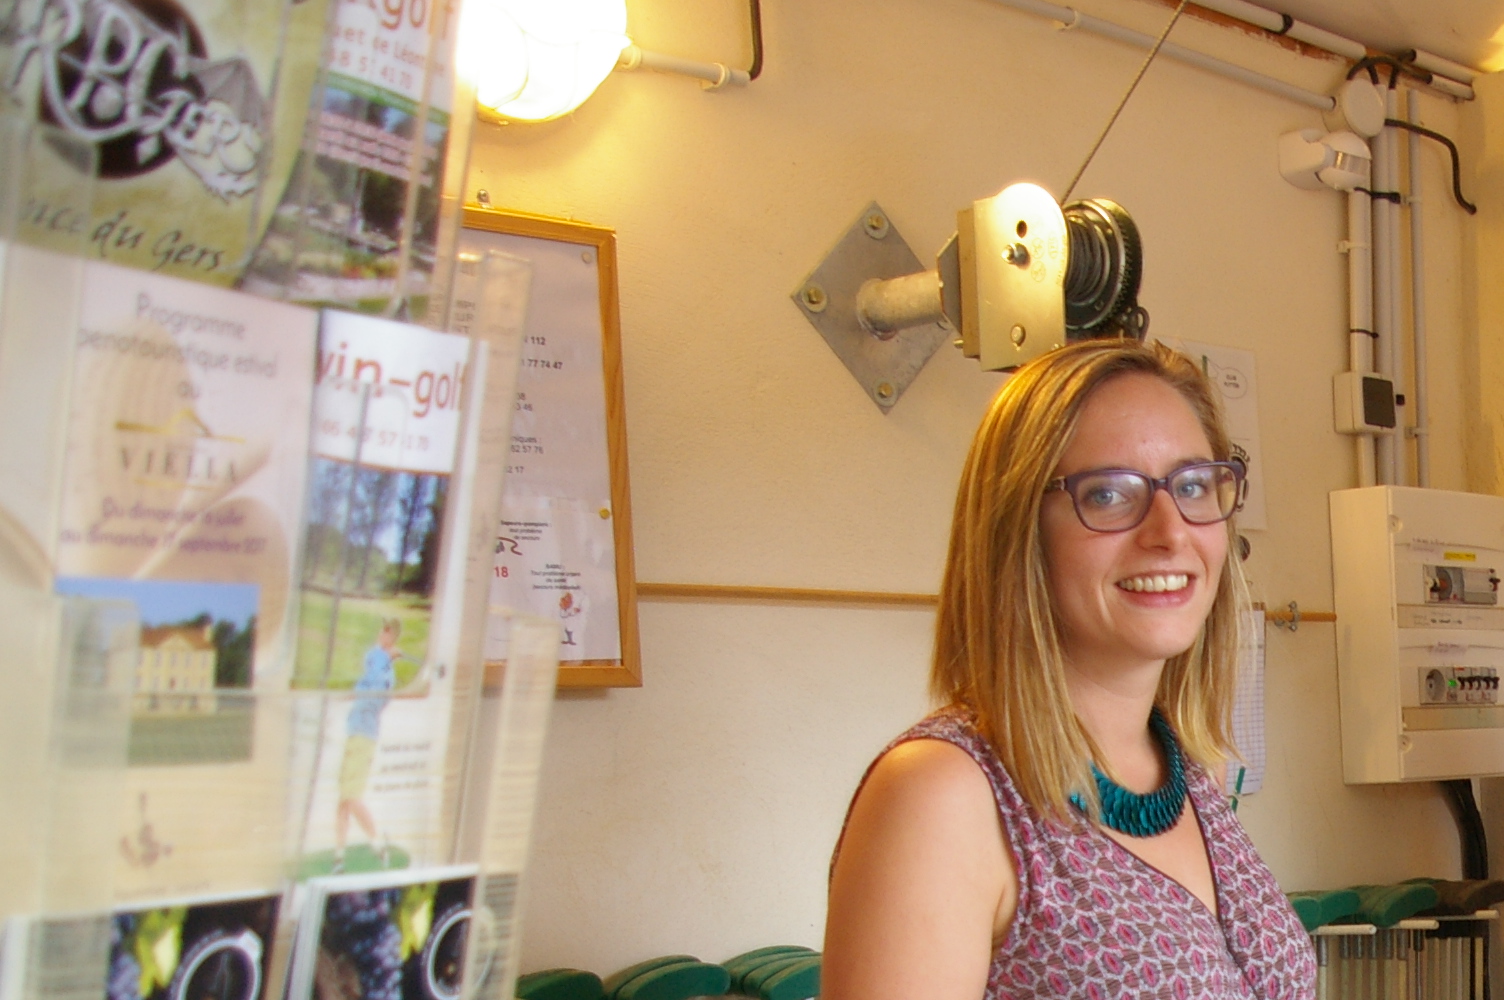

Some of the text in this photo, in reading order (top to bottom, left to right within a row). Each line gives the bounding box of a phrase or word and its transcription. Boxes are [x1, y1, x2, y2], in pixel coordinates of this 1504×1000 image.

[90, 210, 146, 258] du
[153, 229, 226, 271] Gers
[137, 291, 246, 341] Programme
[530, 336, 546, 346] 112
[494, 566, 509, 578] 18
